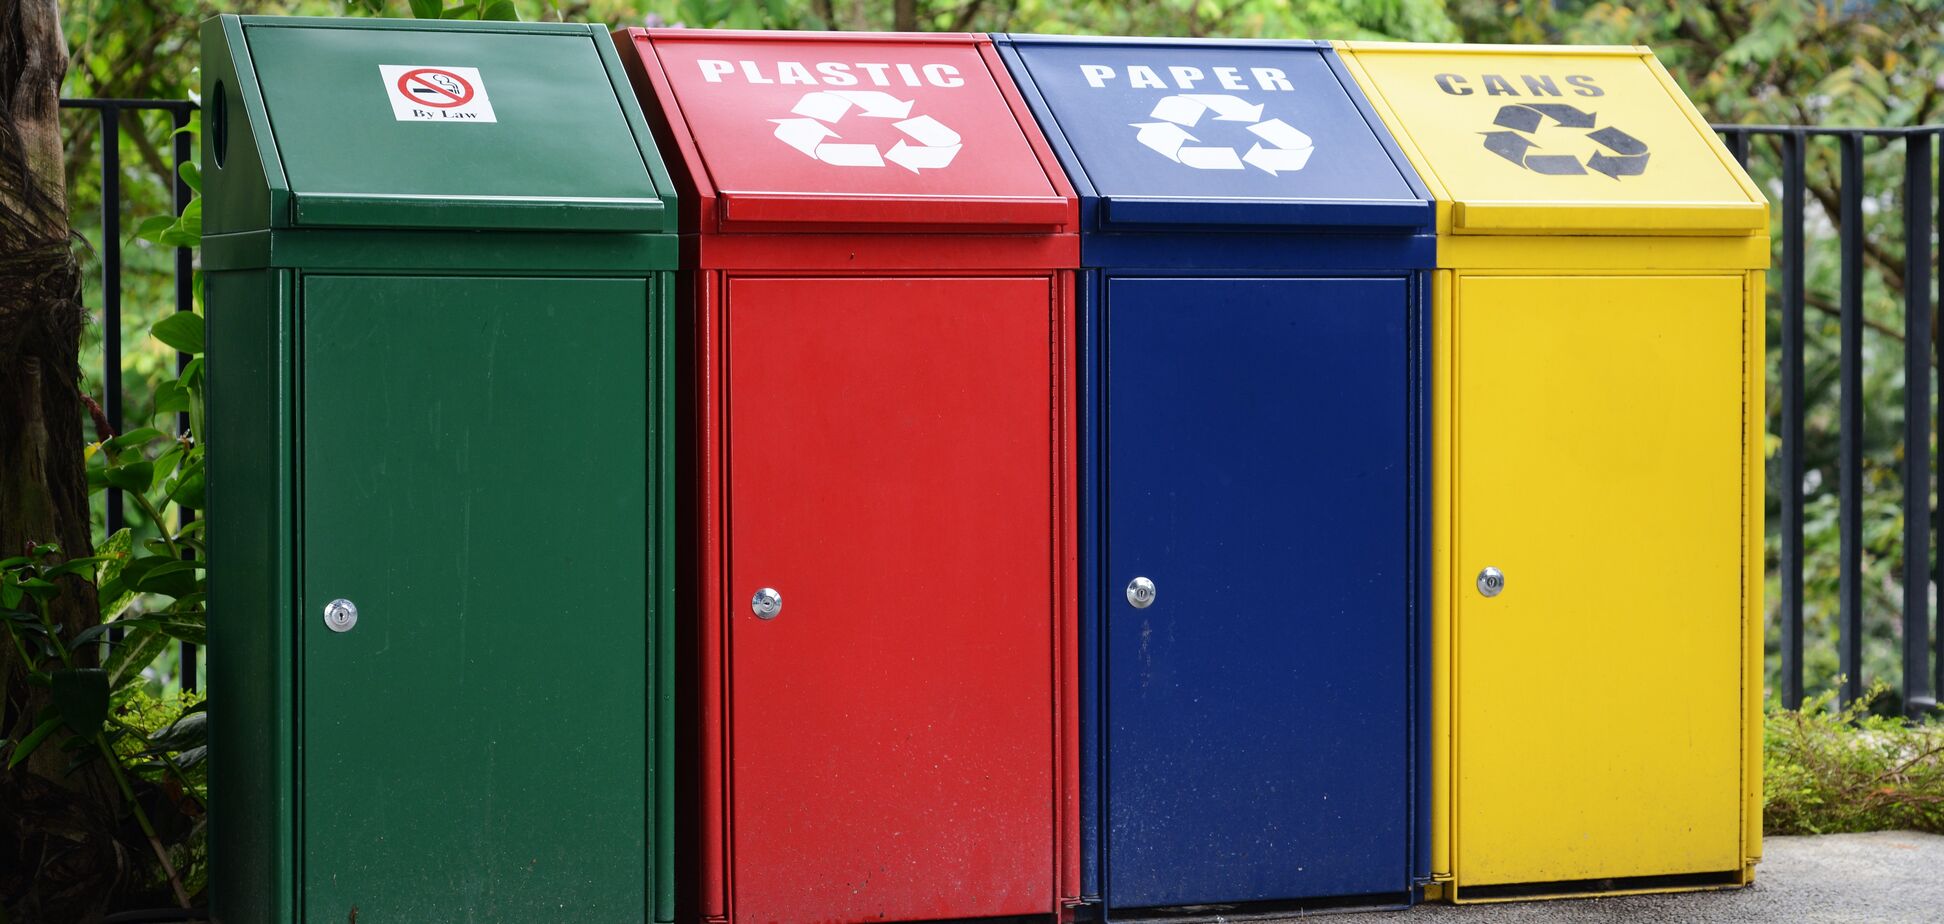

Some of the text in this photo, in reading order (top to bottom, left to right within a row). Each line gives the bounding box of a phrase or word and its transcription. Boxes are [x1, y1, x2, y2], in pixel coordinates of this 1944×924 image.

[697, 59, 965, 88] PLASTIC
[1079, 64, 1295, 91] PAPER
[1434, 73, 1605, 97] CANS
[412, 109, 477, 119] By Law
